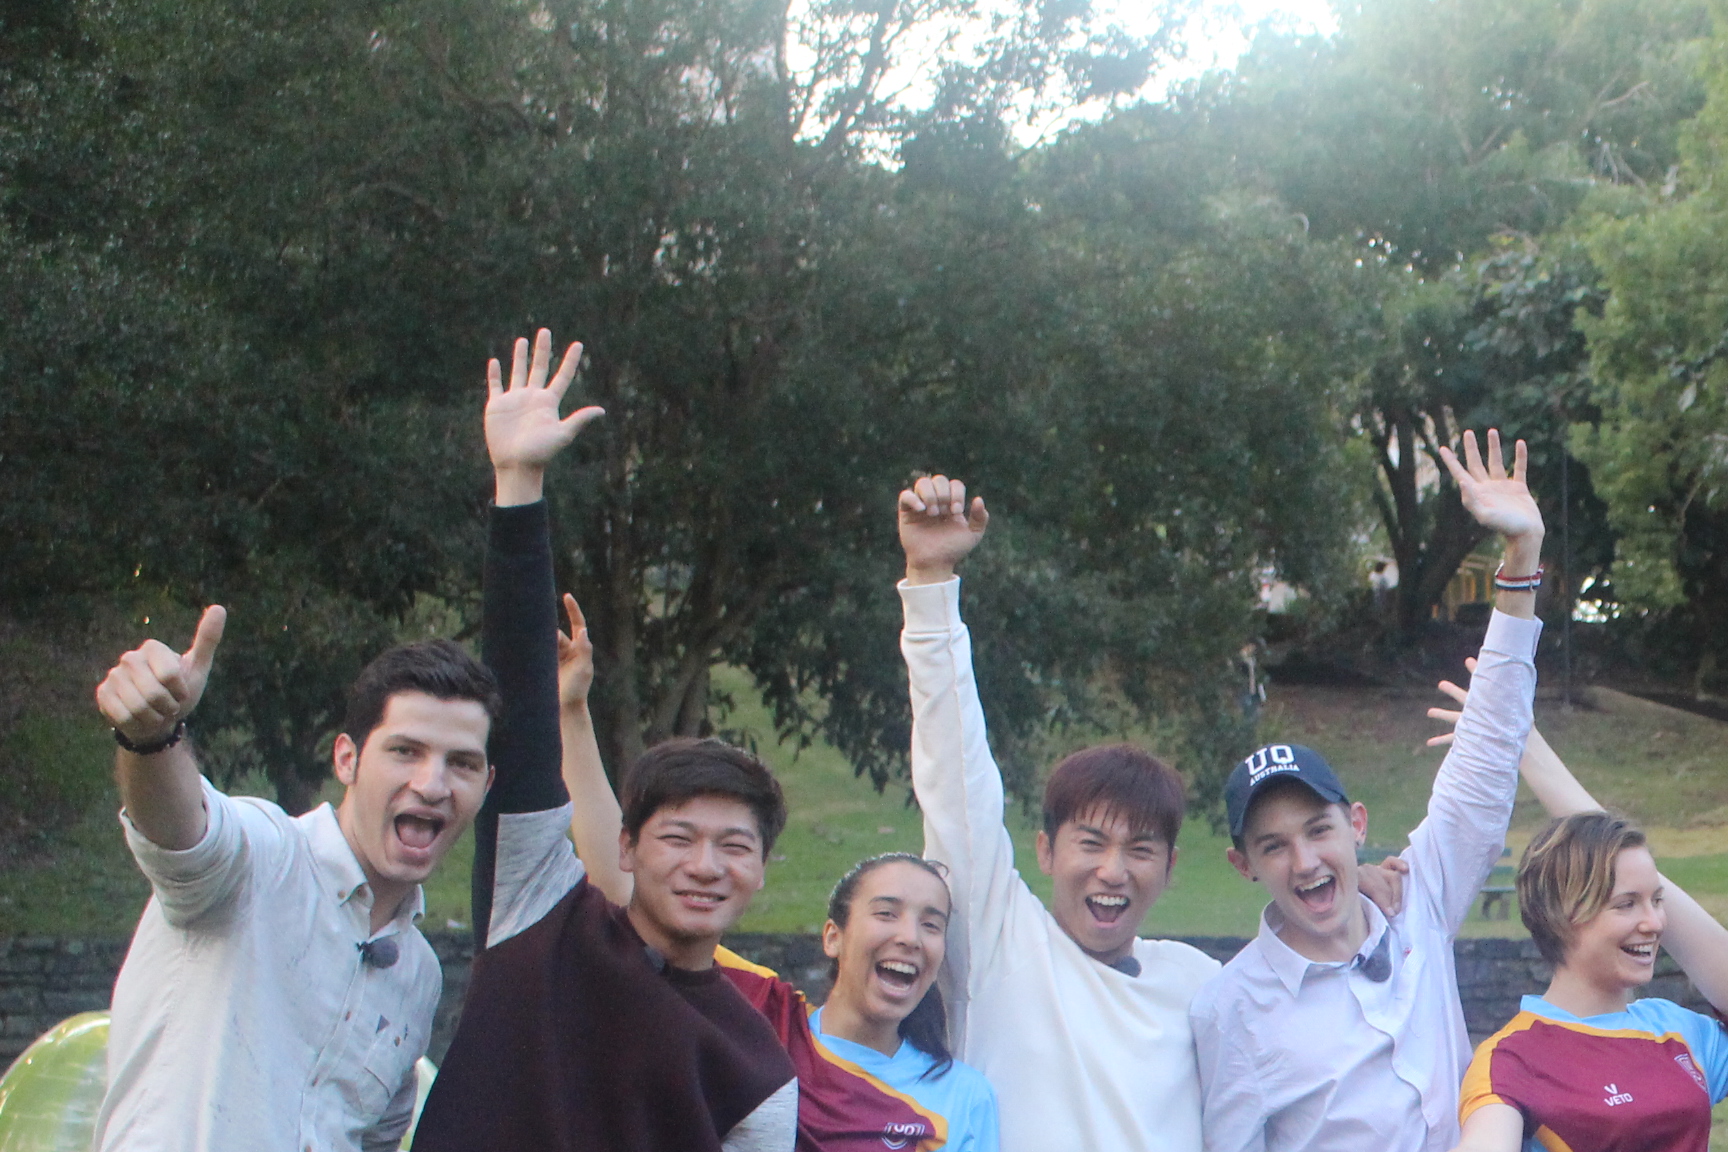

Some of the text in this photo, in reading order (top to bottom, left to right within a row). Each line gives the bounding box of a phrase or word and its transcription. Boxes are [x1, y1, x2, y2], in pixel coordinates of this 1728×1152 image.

[1245, 745, 1295, 776] UQ
[1249, 764, 1300, 787] AUSTRALIA
[1603, 1092, 1634, 1107] VETO
